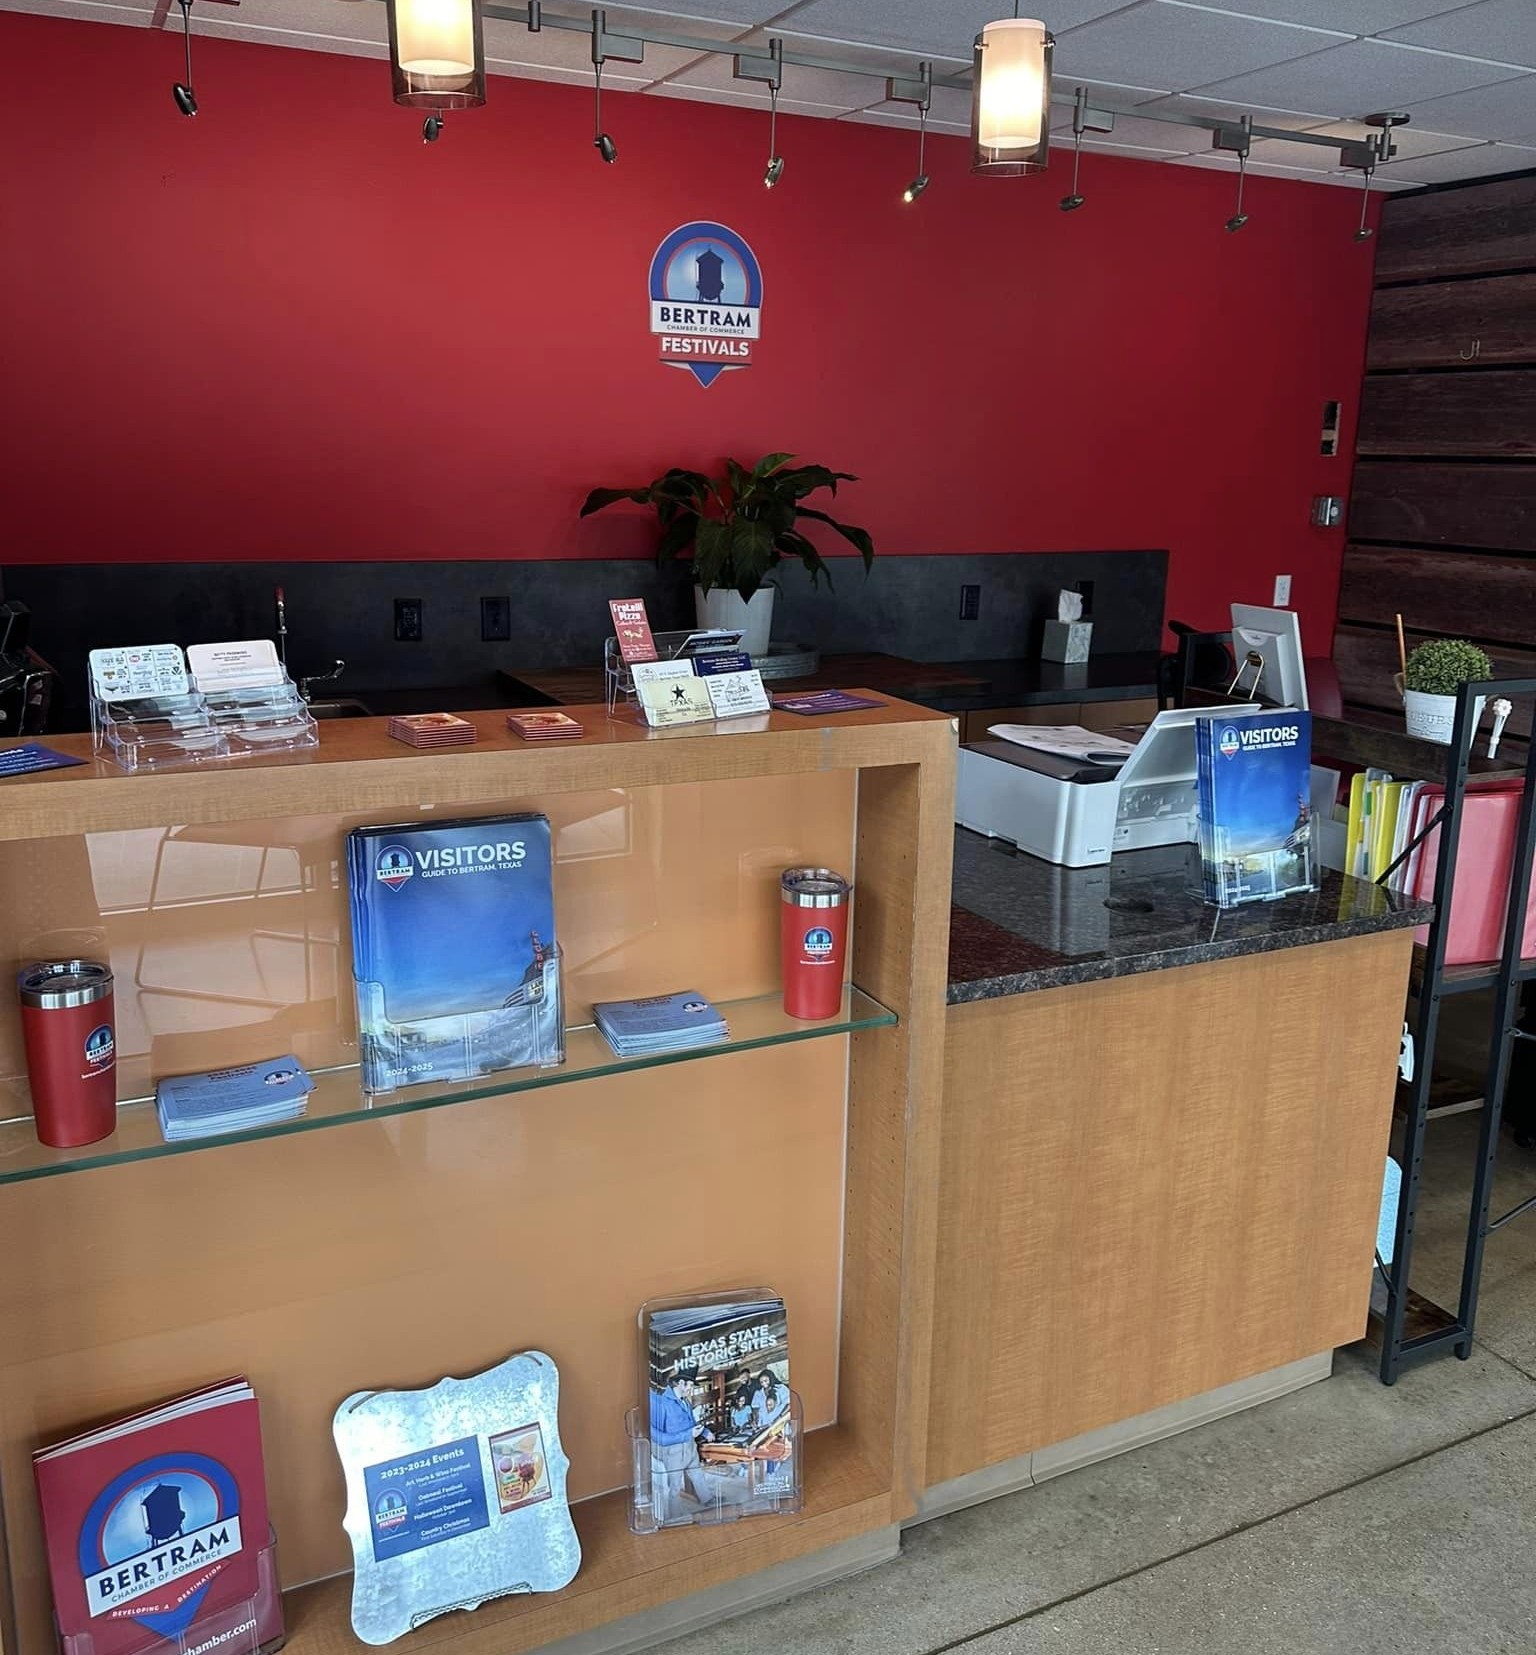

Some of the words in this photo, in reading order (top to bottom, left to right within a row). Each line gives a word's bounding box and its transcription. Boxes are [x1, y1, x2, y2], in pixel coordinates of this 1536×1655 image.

[660, 307, 751, 328] BERTRAM
[667, 324, 698, 332] CHAMBER
[709, 326, 745, 335] COMMERCE
[662, 337, 749, 356] FESTIVALS
[612, 603, 644, 613] Fratelli
[618, 612, 641, 621] Pizza
[1240, 726, 1299, 745] VISITORS
[415, 841, 526, 869] VISITORS
[379, 867, 411, 876] BERTRAM
[421, 867, 446, 878] GUIDE
[446, 867, 458, 875] TO
[499, 860, 522, 869] TEXAS
[385, 1062, 433, 1076] 2024-2025
[681, 1336, 726, 1357] TEXAS
[728, 1324, 769, 1345] STATE
[674, 1344, 737, 1371] HISTORIC
[740, 1334, 777, 1353] SITES
[380, 1459, 431, 1479] 2023-2024
[432, 1448, 465, 1464] Events
[442, 1482, 464, 1493] Festival
[414, 1507, 443, 1520] Halloween
[443, 1498, 473, 1511] Downtown
[421, 1526, 443, 1537] Country
[443, 1517, 470, 1529] Christmas
[99, 1527, 230, 1598] BERTRAM
[111, 1577, 156, 1603] CHAMBER
[158, 1571, 170, 1581] OF
[172, 1550, 221, 1575] COMMERCE
[112, 1605, 160, 1617] DEVELOPING
[176, 1564, 222, 1603] DESTINATION
